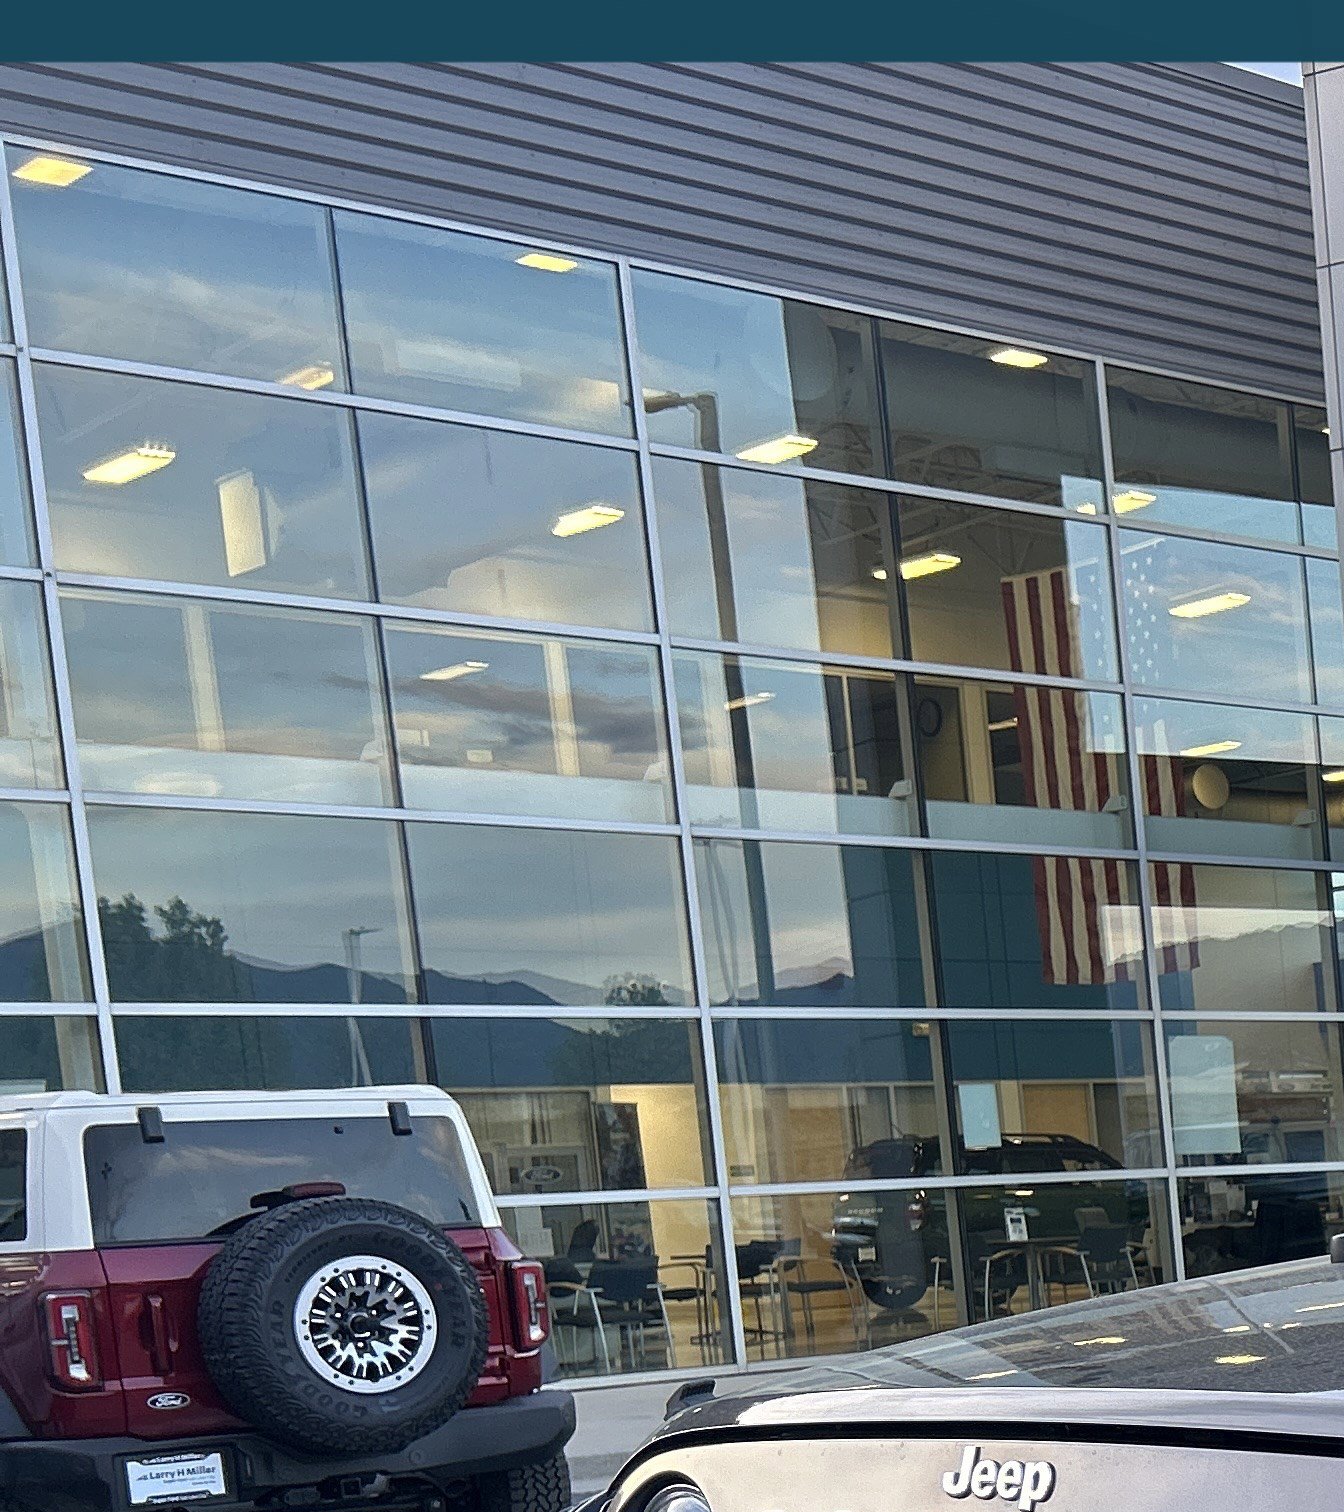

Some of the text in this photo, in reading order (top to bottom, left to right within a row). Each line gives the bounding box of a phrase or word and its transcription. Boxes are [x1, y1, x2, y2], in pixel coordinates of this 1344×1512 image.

[149, 1470, 176, 1480] Larry
[177, 1468, 185, 1477] H
[186, 1465, 217, 1476] Miller
[942, 1446, 1057, 1512] Jeep
